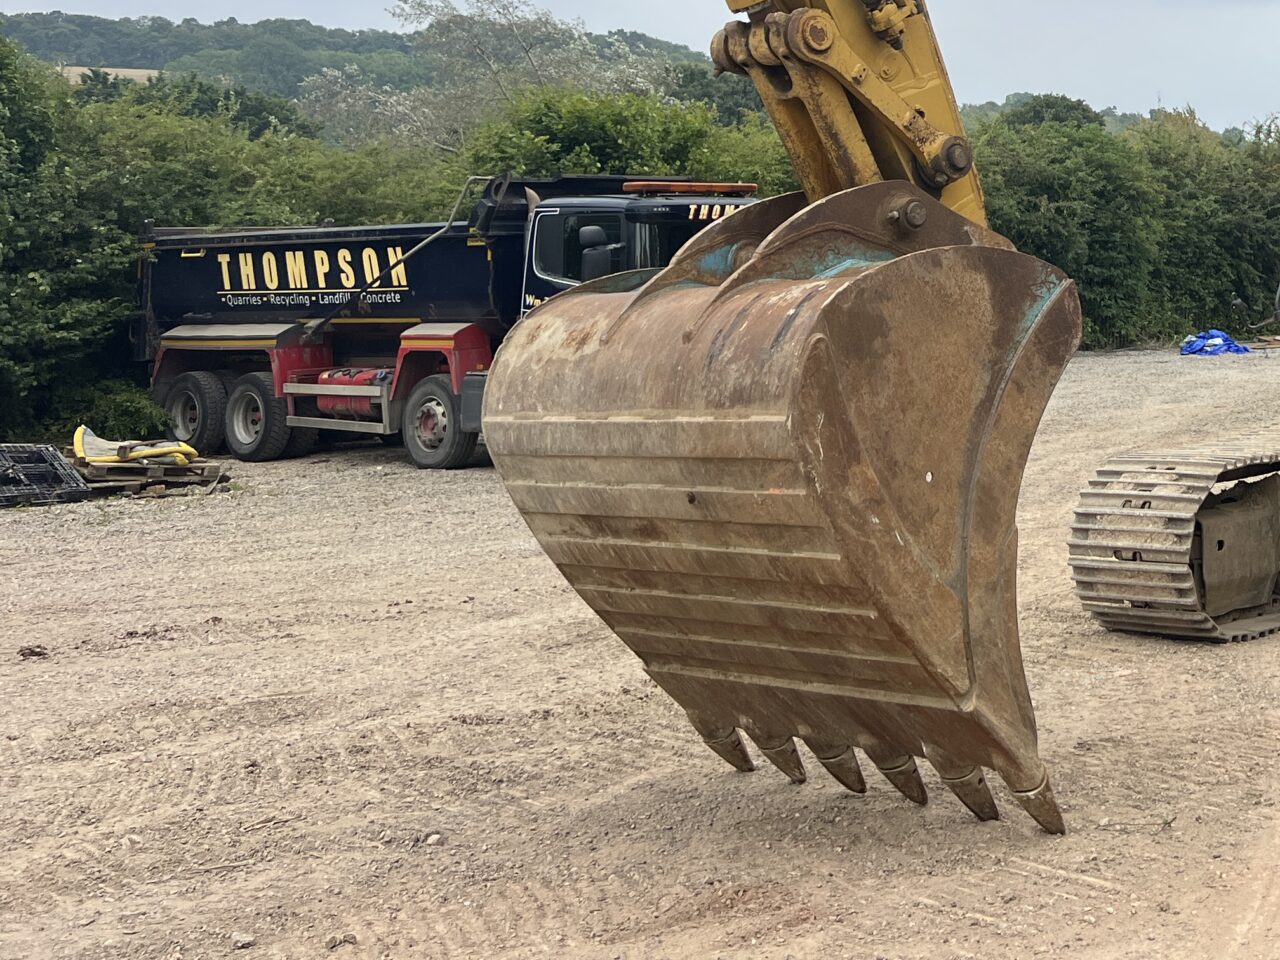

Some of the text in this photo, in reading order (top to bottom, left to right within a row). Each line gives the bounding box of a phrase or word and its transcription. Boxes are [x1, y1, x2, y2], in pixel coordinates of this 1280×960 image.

[217, 246, 408, 290] THOMPSON
[226, 294, 262, 307] Quarries
[270, 293, 310, 307] Recycling
[360, 292, 401, 303] Concrete
